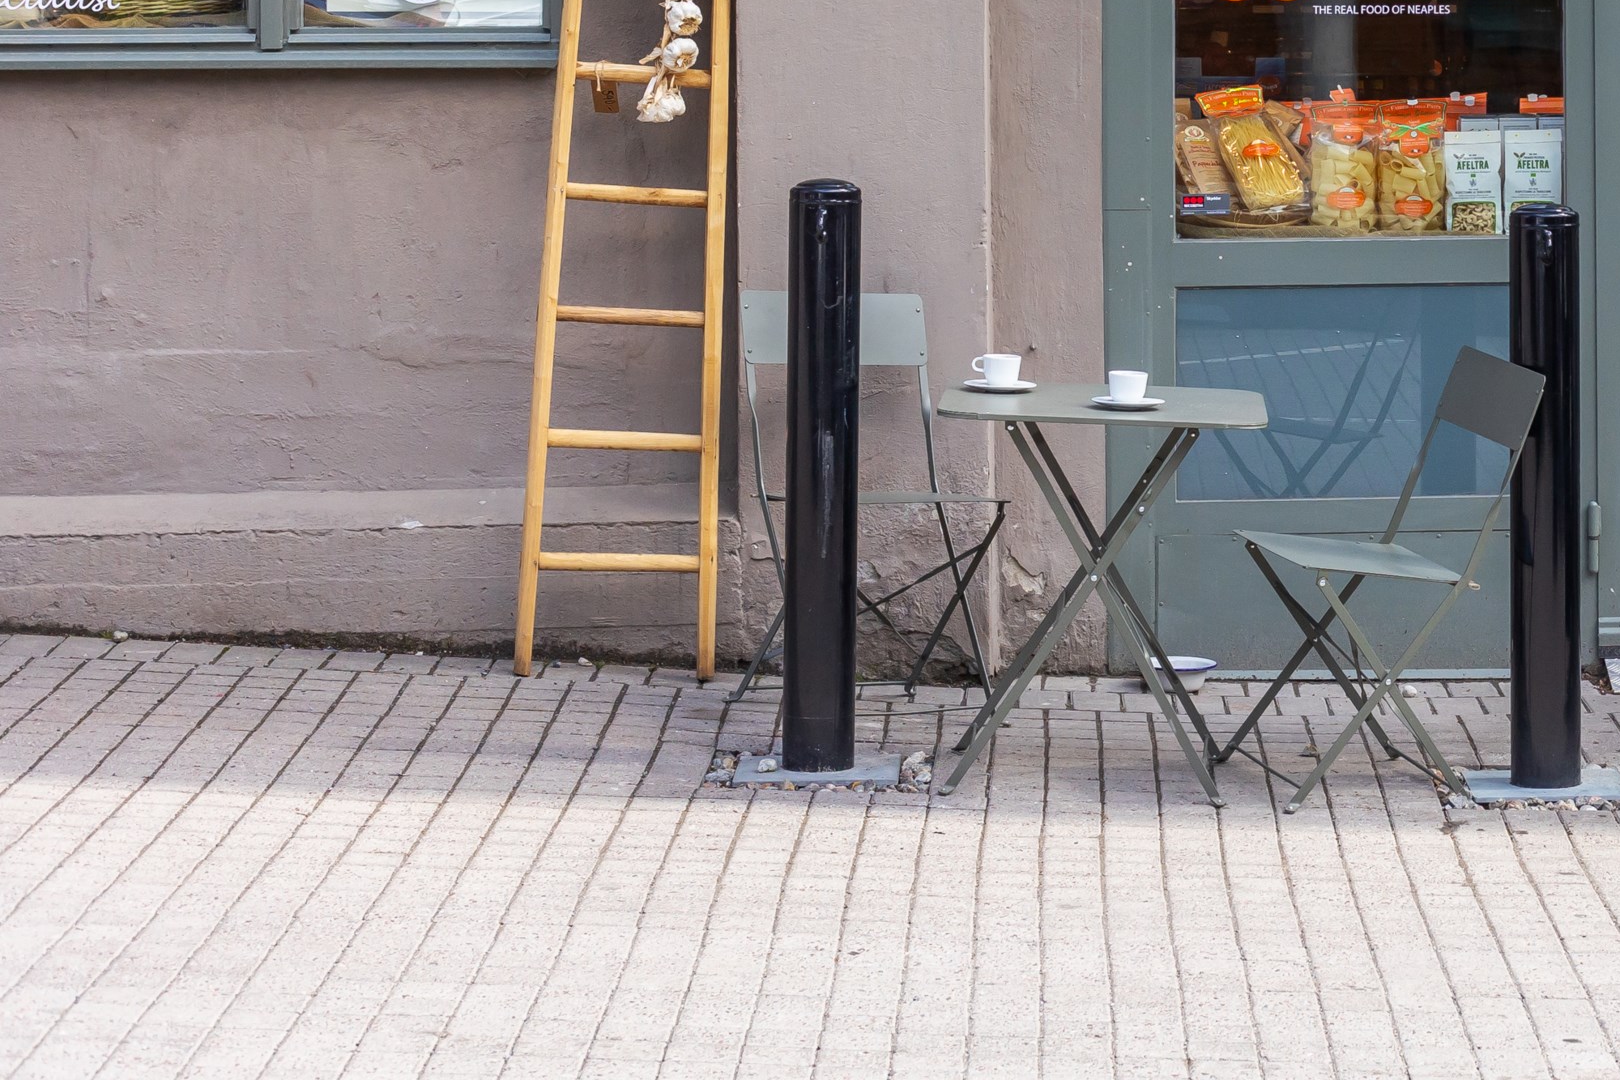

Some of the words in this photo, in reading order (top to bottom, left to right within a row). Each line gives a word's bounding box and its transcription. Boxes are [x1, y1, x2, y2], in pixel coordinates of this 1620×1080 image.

[1312, 5, 1333, 15] THE
[1334, 4, 1359, 15] REAL
[1360, 4, 1390, 14] FOOD
[1391, 4, 1406, 14] OF
[1407, 4, 1451, 14] NEAPLES
[1456, 160, 1490, 170] AFELTRA
[1516, 159, 1550, 170] AFELTRA
